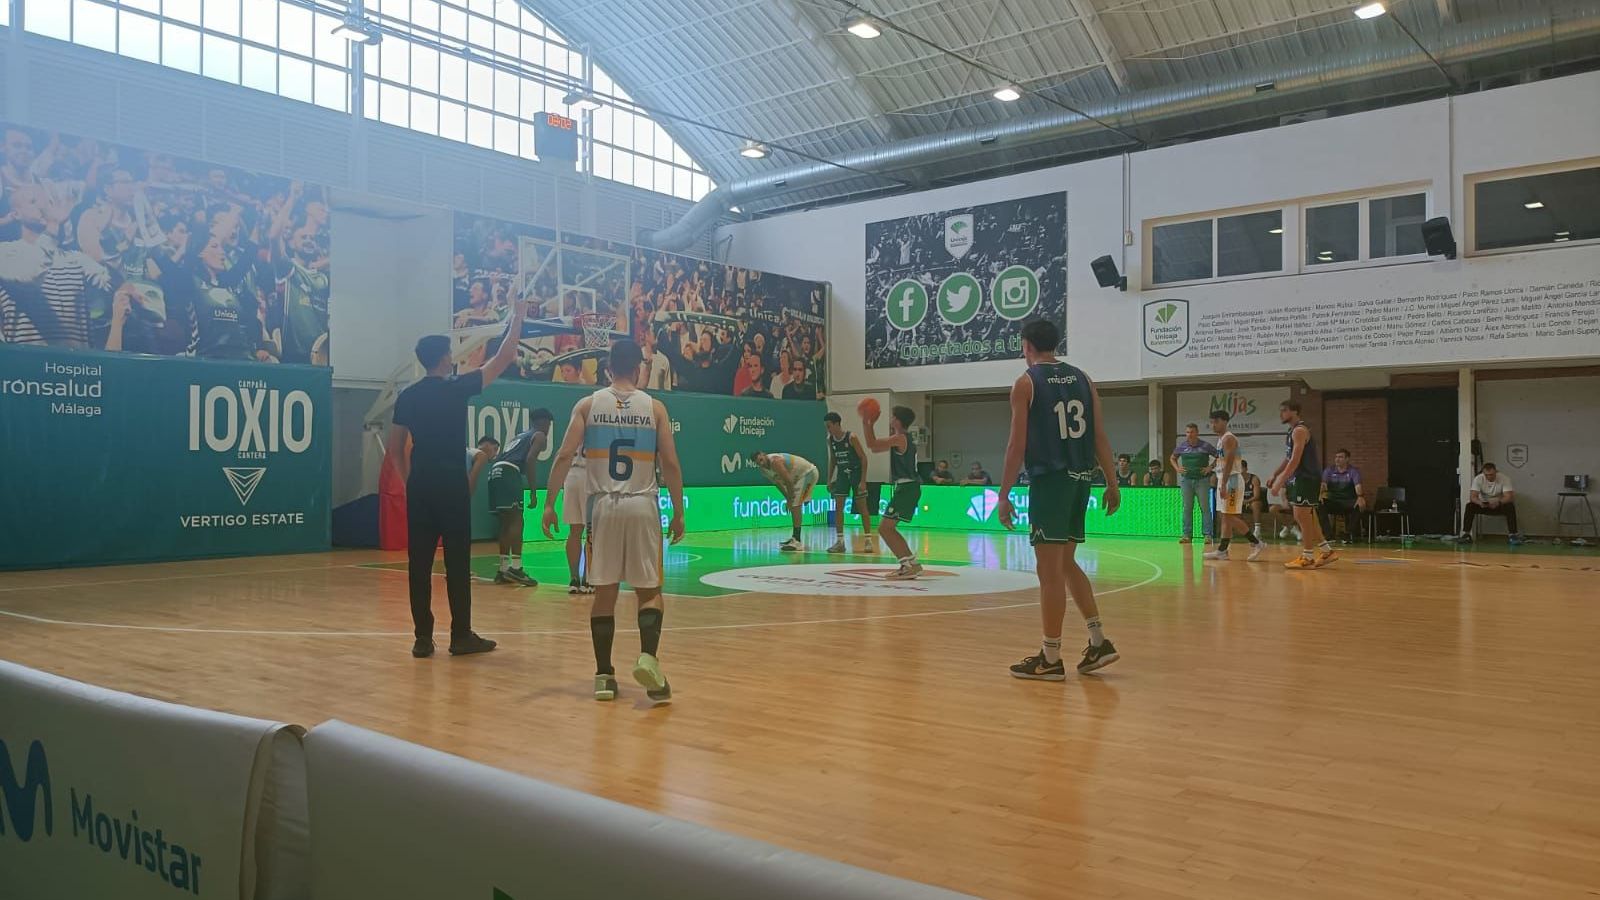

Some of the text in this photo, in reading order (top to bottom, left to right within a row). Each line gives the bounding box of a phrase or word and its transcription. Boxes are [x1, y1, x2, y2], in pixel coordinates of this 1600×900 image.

[901, 340, 991, 360] Conectados
[995, 339, 1005, 353] a
[45, 361, 102, 377] Hospital
[51, 402, 102, 418] Málaga
[1210, 391, 1257, 421] Mijas
[592, 413, 652, 426] VILLANUEVA
[739, 415, 775, 429] Fundación
[1053, 399, 1087, 440] 13
[739, 425, 766, 438] Unicaja
[608, 438, 636, 482] 6
[180, 512, 305, 529] VERTIGO ESTATE
[70, 786, 202, 896] Movistar
